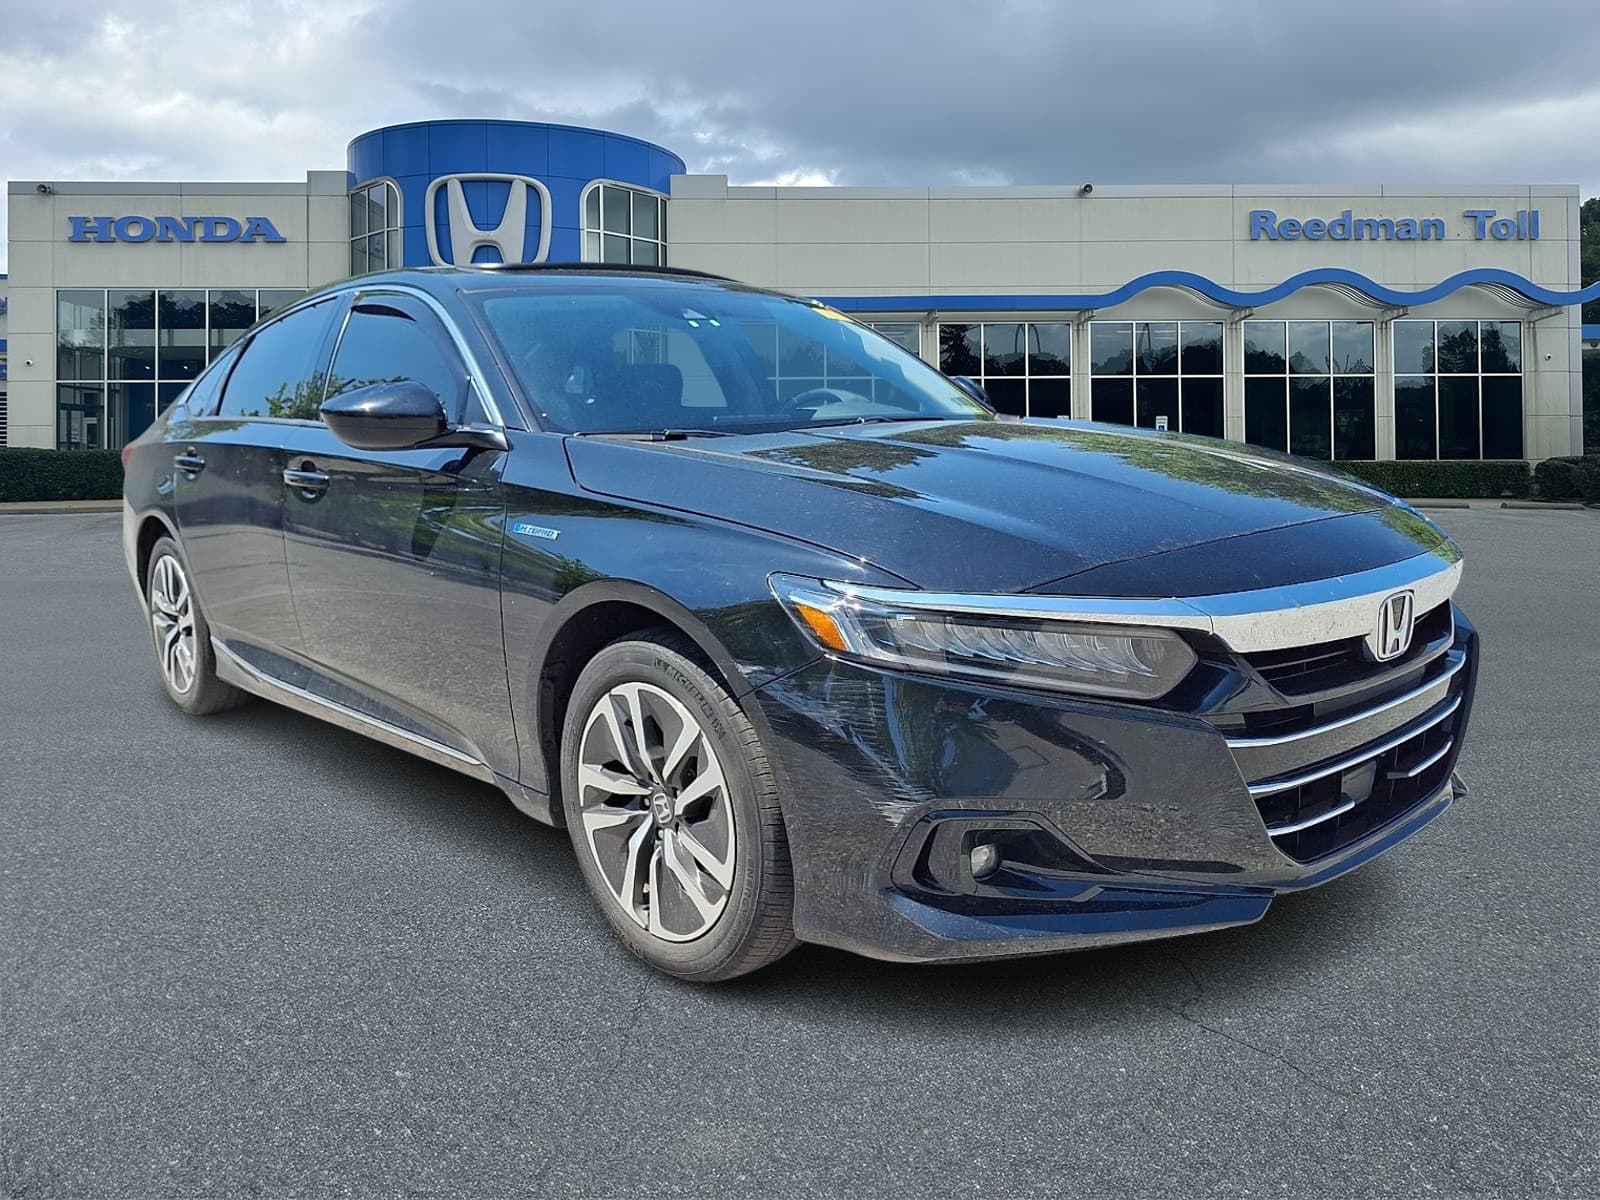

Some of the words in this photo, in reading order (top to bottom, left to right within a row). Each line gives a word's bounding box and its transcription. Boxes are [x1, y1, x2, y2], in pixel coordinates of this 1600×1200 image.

[68, 216, 287, 242] HONDA
[1249, 209, 1446, 241] Reedman
[1463, 209, 1540, 241] Toll
